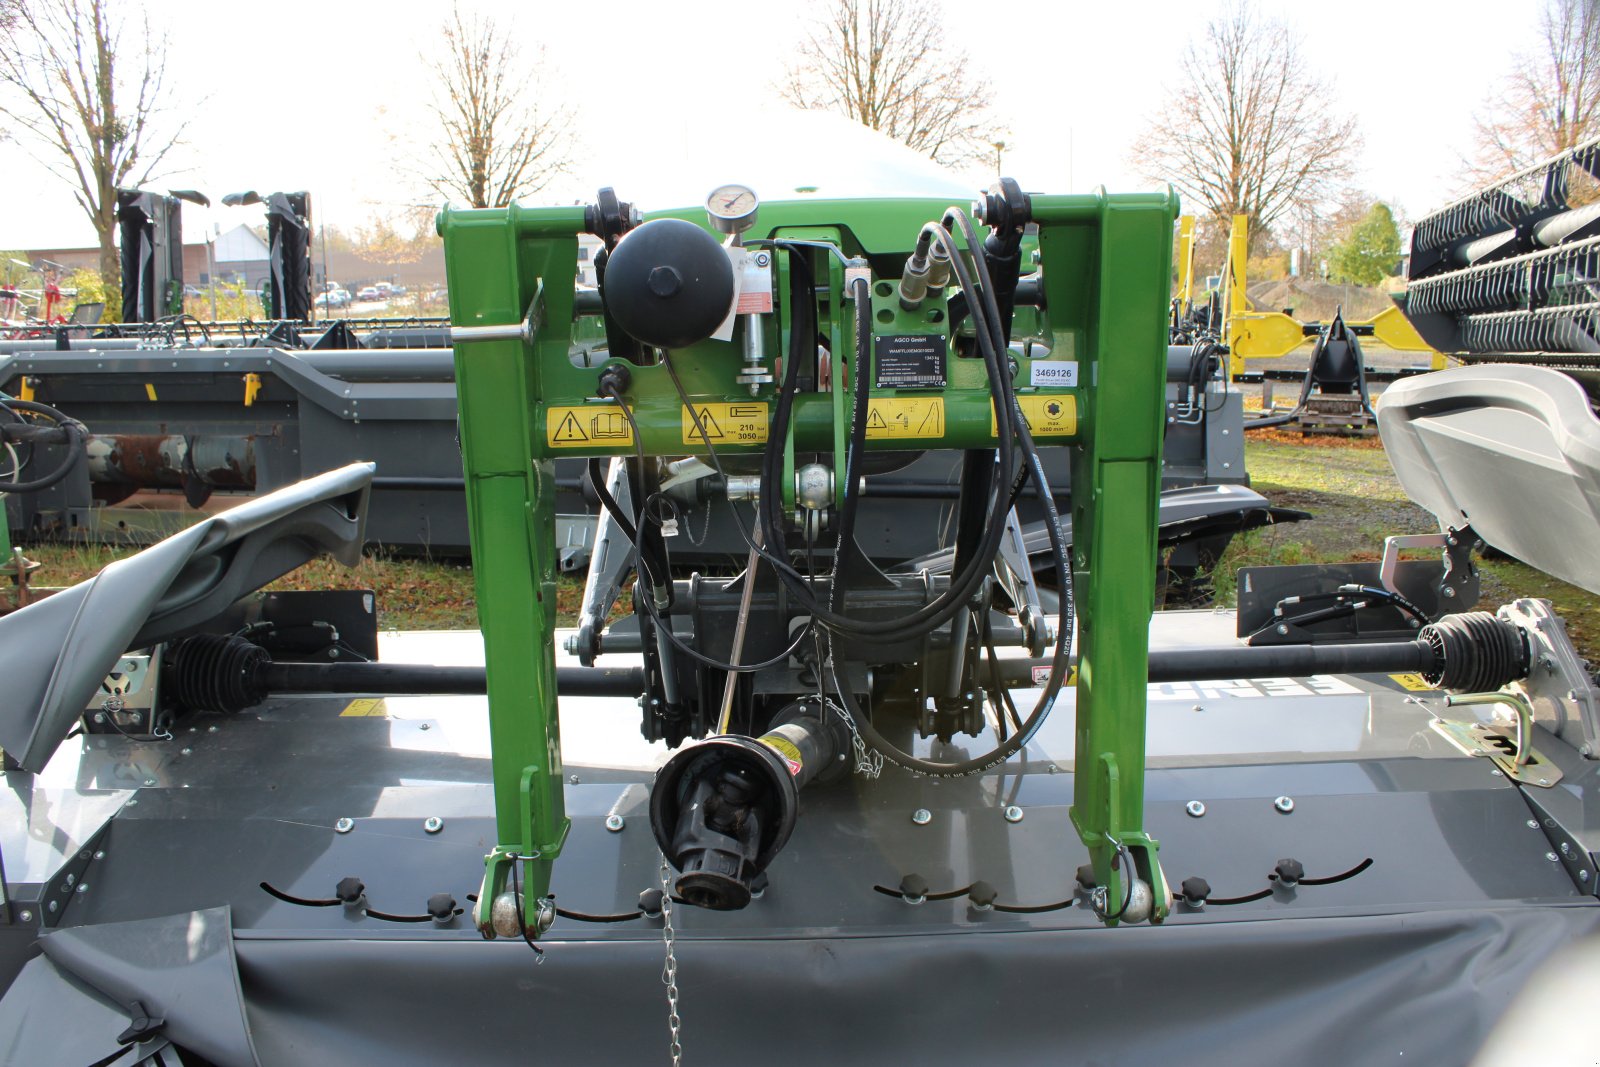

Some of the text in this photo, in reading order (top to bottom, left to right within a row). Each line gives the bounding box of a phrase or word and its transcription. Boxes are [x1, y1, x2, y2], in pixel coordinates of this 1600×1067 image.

[1036, 369, 1072, 377] 3469126
[1053, 516, 1060, 527] EN
[1063, 562, 1070, 574] DN
[1065, 576, 1071, 584] 10
[1066, 588, 1073, 601] WP
[1147, 674, 1365, 700] FEND
